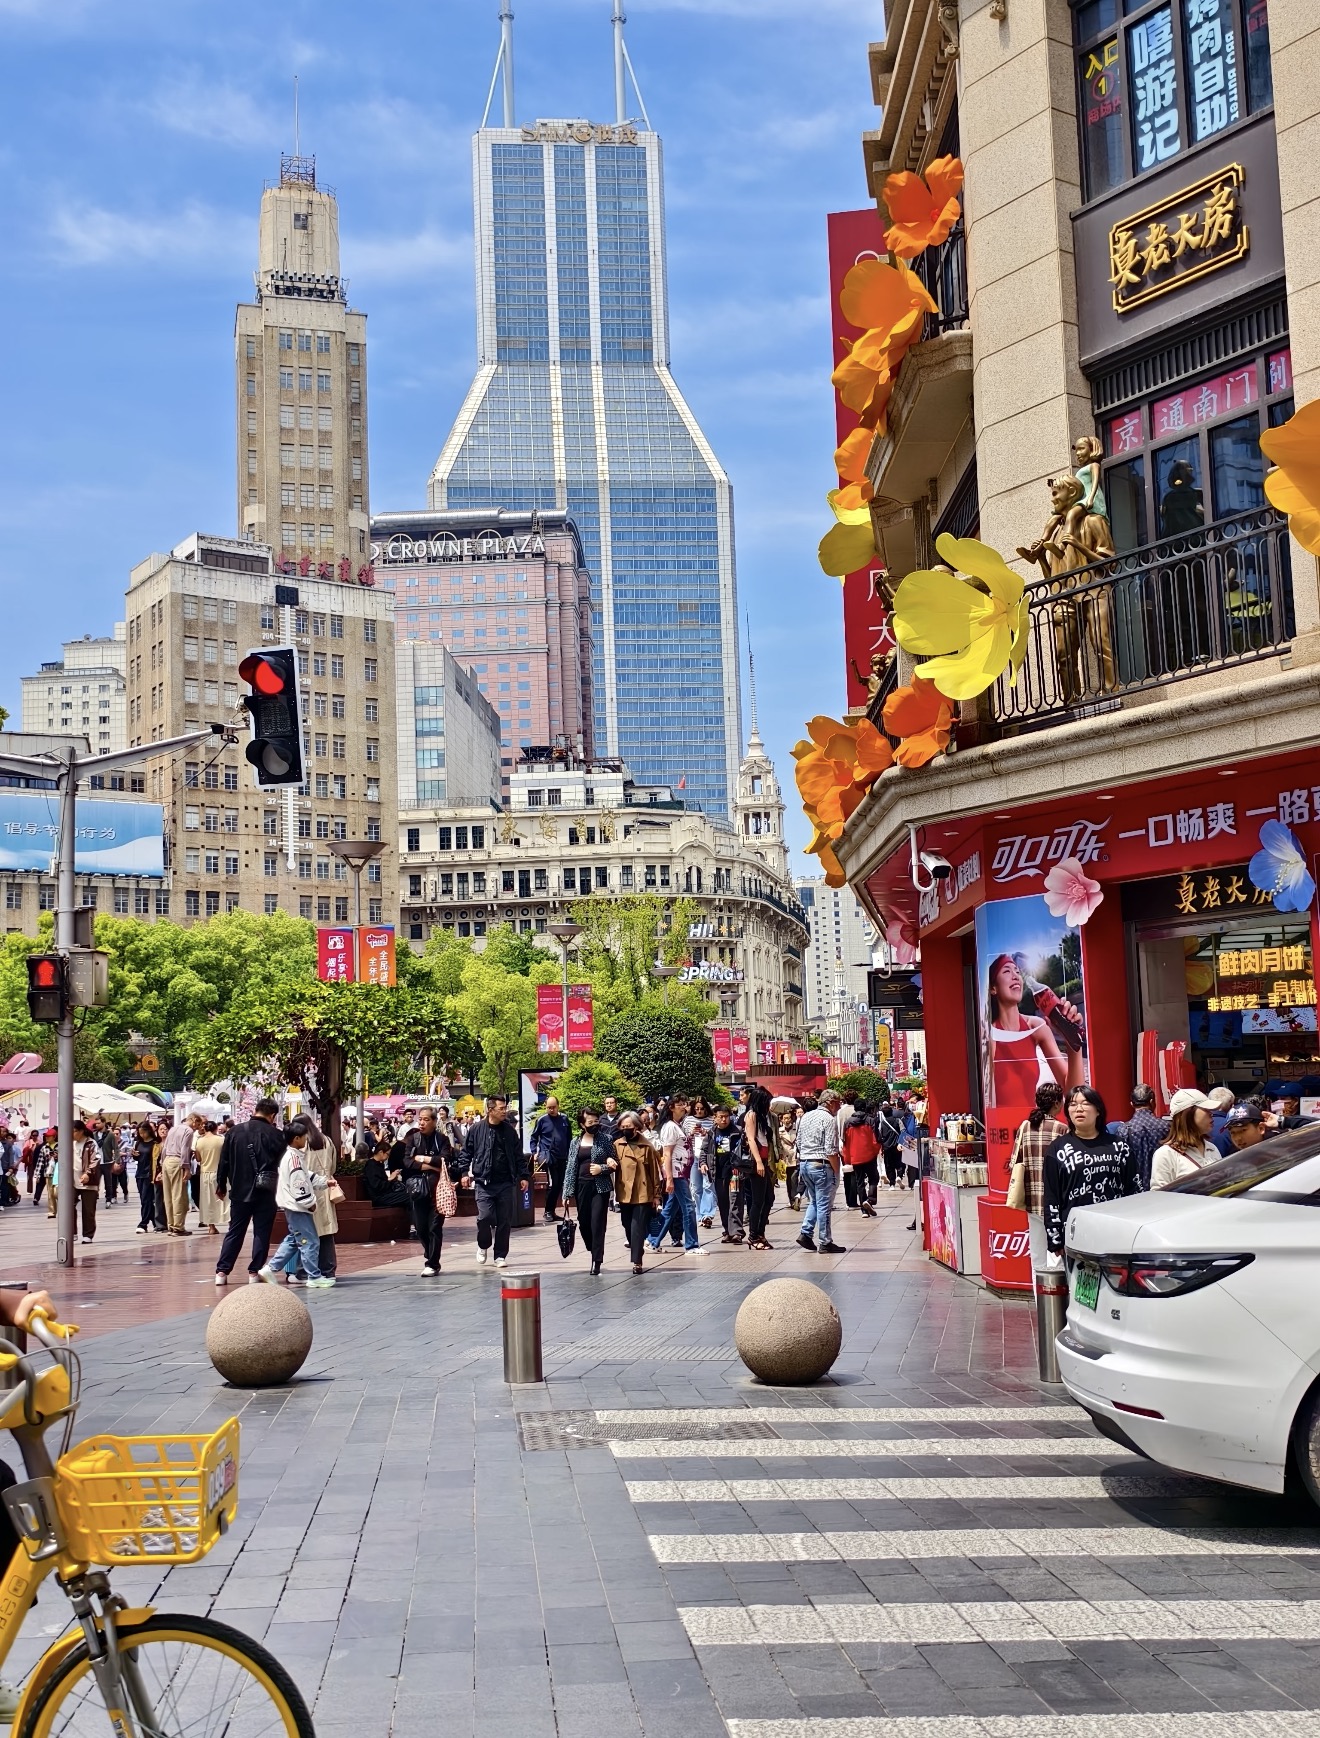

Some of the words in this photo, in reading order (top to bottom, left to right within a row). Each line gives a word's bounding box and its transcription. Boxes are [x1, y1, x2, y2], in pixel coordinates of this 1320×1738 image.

[1132, 8, 1180, 168] 嘻游记
[388, 543, 473, 559] CROWNE
[482, 536, 545, 554] PLAZA
[4, 822, 116, 840] 倡导节行为
[992, 818, 1109, 882] 可口可乐
[1118, 803, 1237, 848] 一口畅爽
[1246, 785, 1320, 825] 一路
[1218, 945, 1305, 977] 鲜肉月饼
